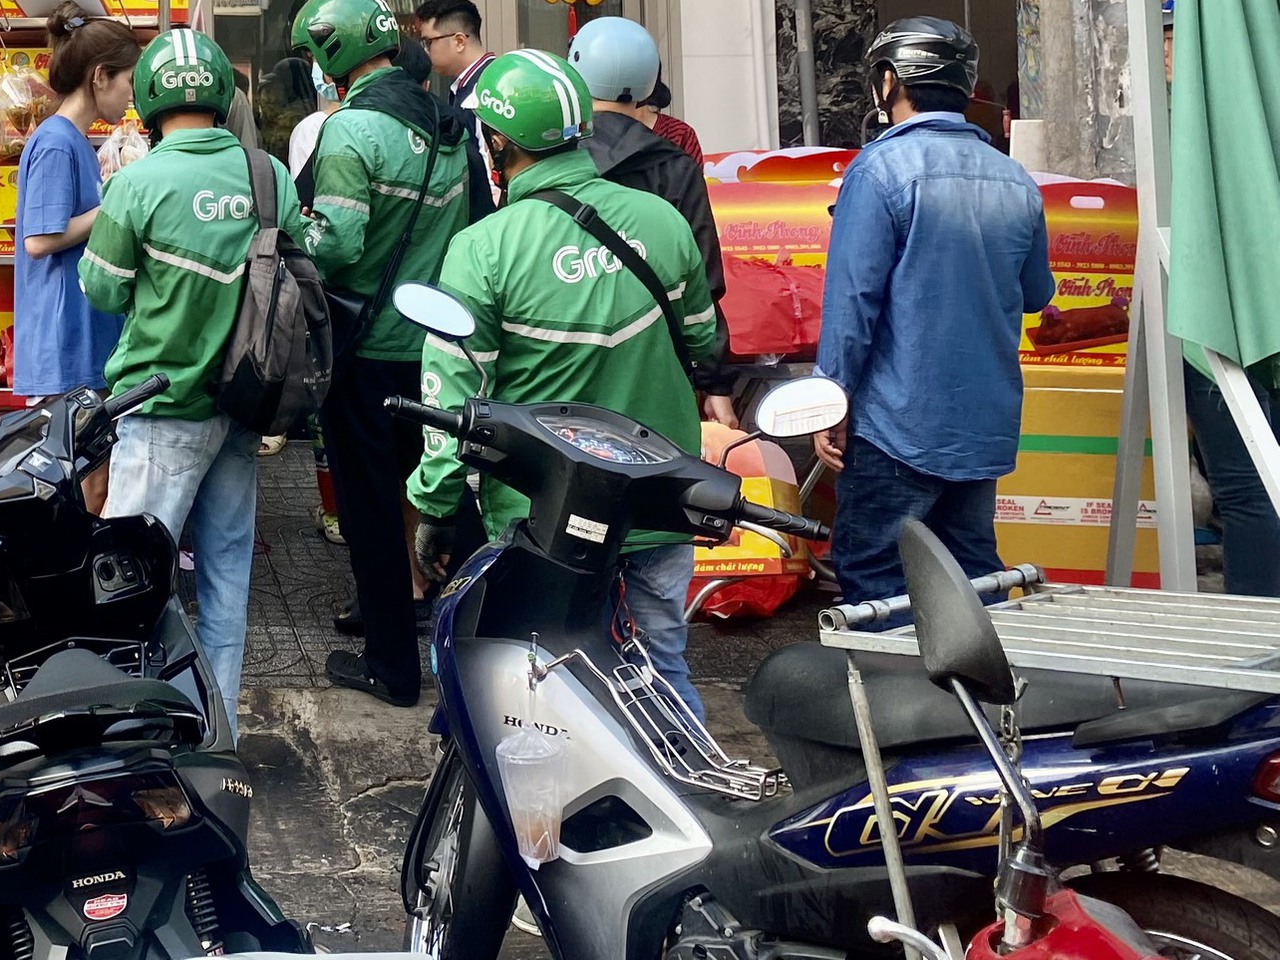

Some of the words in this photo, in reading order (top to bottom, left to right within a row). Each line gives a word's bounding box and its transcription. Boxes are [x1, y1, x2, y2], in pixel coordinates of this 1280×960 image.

[161, 65, 214, 90] Grab
[480, 88, 516, 120] Grab
[192, 189, 254, 222] Gra
[764, 220, 823, 243] Phong
[71, 870, 127, 889] HONDA
